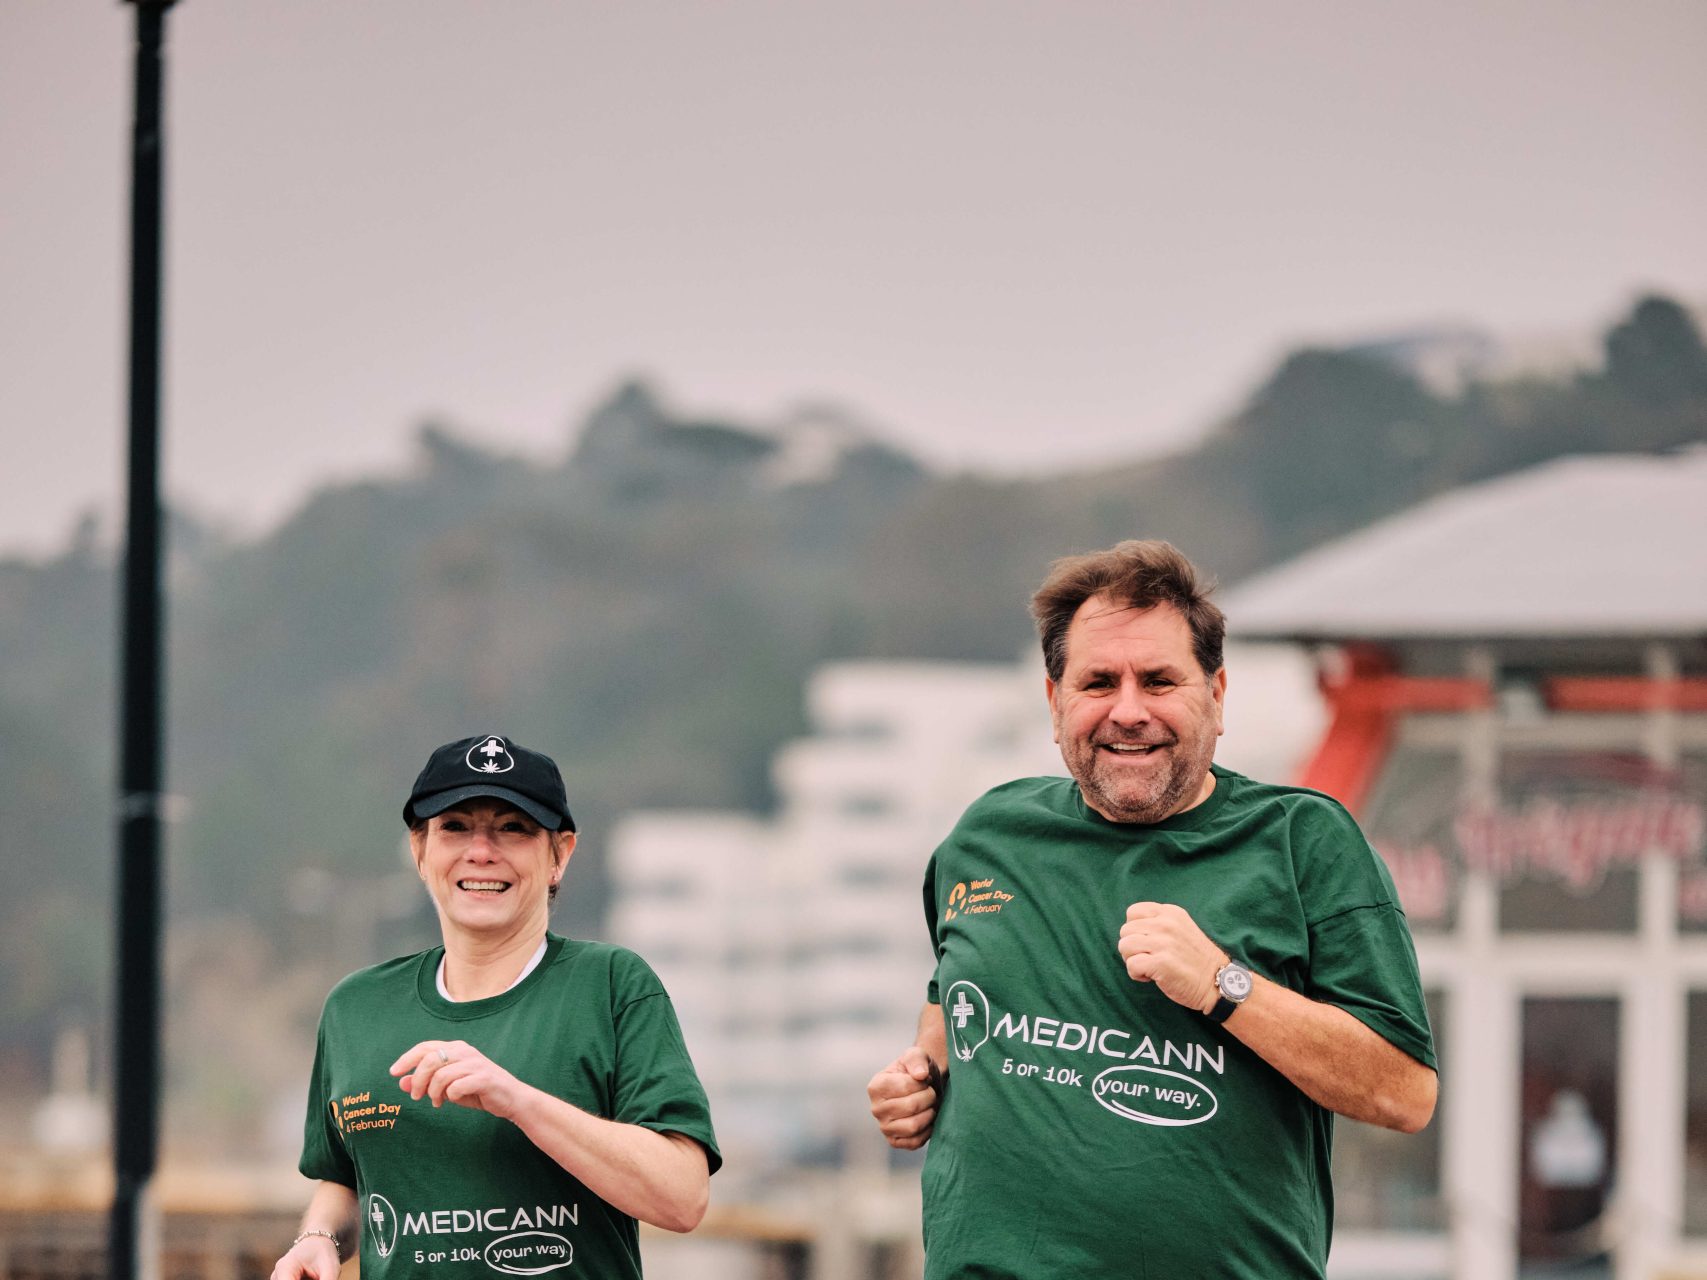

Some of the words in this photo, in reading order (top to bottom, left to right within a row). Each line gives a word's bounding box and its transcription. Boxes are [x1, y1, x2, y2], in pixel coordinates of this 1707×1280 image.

[970, 878, 994, 891] World
[993, 890, 1015, 903] Day
[970, 904, 1002, 914] February
[993, 1012, 1224, 1075] MEDICANN
[1001, 1058, 1014, 1075] 5
[1016, 1062, 1039, 1076] or
[1043, 1067, 1083, 1087] 10k
[1098, 1077, 1149, 1096] your
[1154, 1086, 1201, 1109] way.
[342, 1091, 370, 1107] World
[343, 1106, 376, 1120] Cancer
[378, 1103, 401, 1116] Day
[351, 1118, 396, 1132] February
[402, 1203, 578, 1236] MEDICANN
[414, 1250, 425, 1264] 5
[428, 1251, 446, 1264] or
[450, 1248, 481, 1263] 10k
[493, 1247, 532, 1263] your
